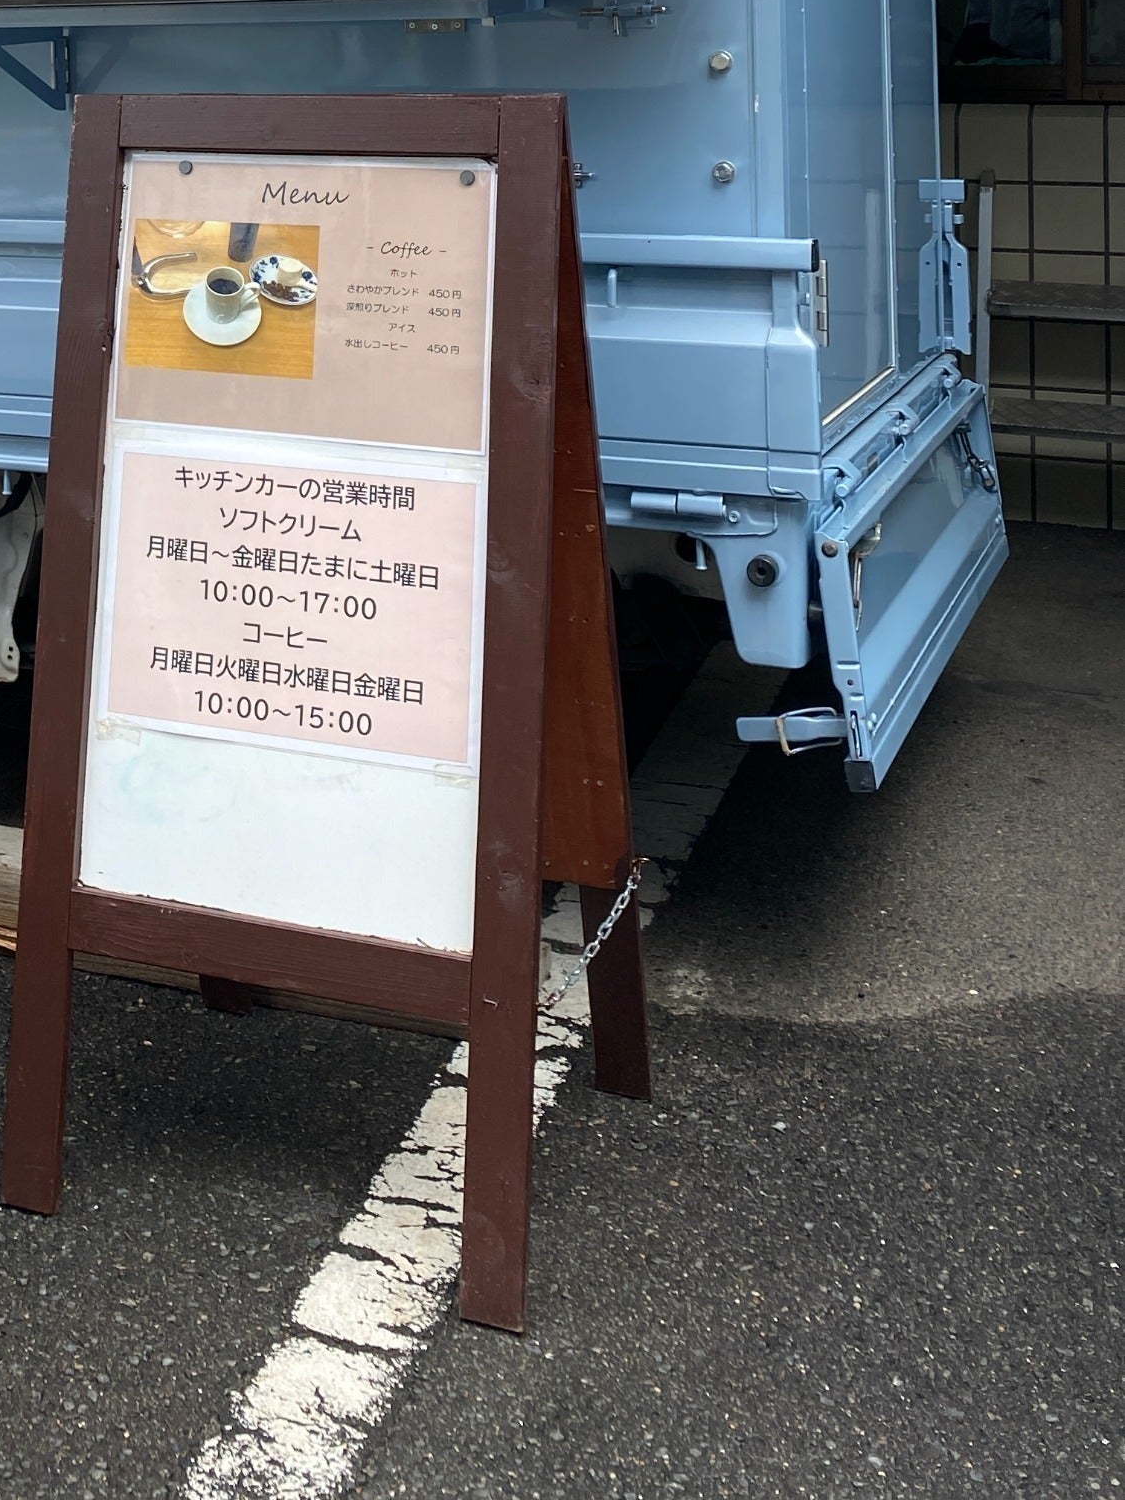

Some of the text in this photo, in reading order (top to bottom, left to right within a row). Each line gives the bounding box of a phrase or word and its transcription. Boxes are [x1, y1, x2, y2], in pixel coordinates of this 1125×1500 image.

[261, 180, 350, 206] Menu
[380, 241, 433, 259] Coffee
[390, 269, 417, 278] ホット
[347, 284, 462, 300] さわやかブレンド 450円
[346, 302, 461, 318] 深煎りブレンド 450円
[388, 322, 416, 333] アイス
[345, 339, 460, 355] 水出しコーヒー 450円
[174, 465, 415, 511] キッチンカーの営業時間
[220, 507, 362, 542] ソフトクリーム
[146, 535, 439, 590] 月曜日～金曜日たまに土曜日
[243, 622, 328, 649] コーヒー
[150, 646, 424, 705] 月曜日火曜日水曜日金曜日
